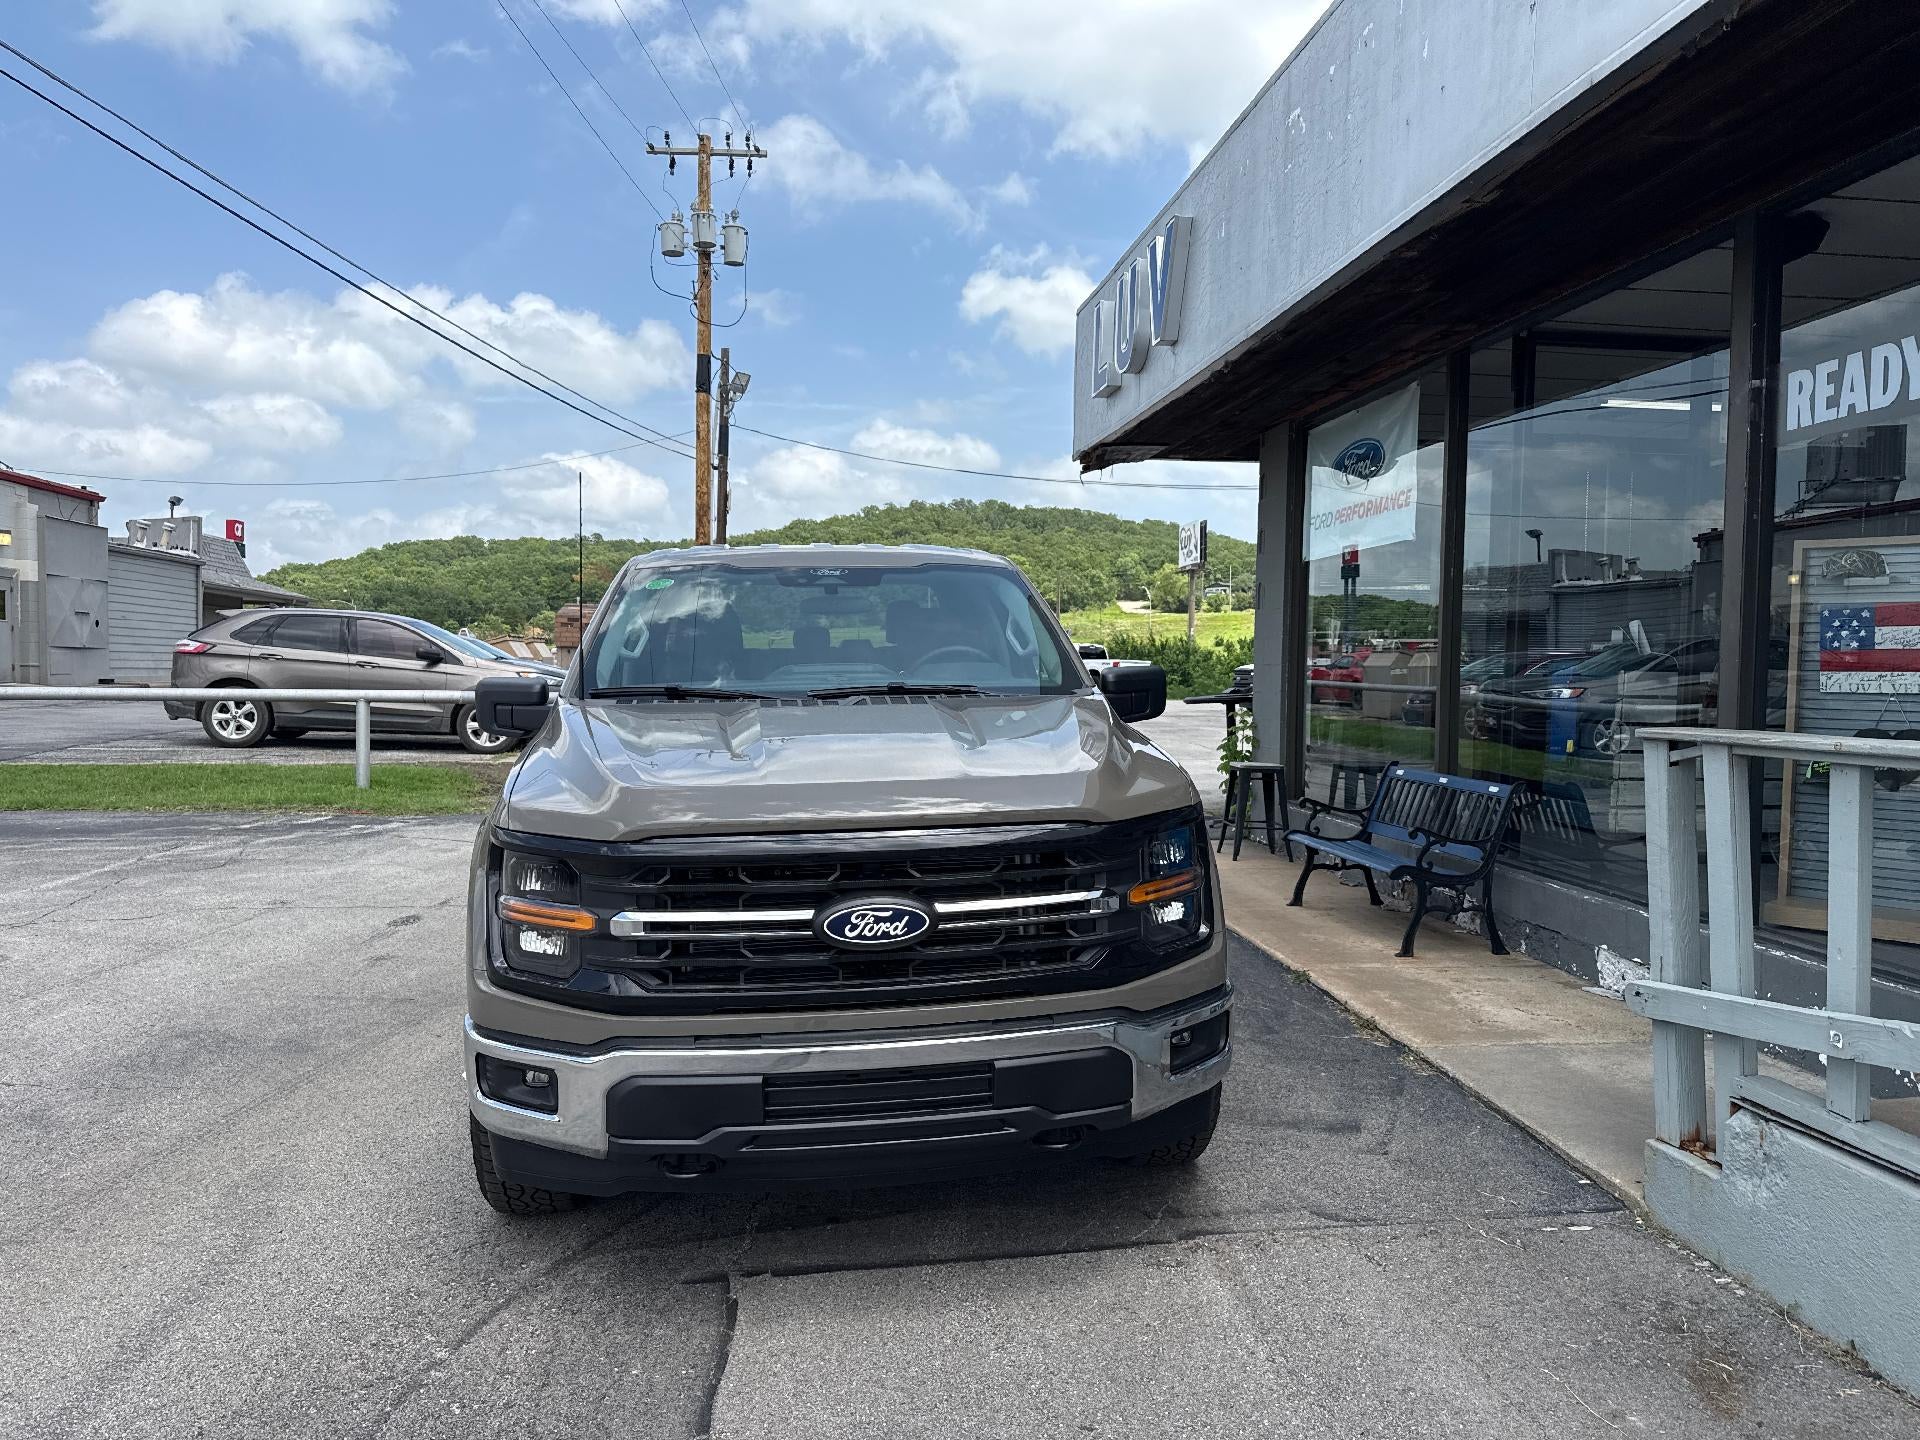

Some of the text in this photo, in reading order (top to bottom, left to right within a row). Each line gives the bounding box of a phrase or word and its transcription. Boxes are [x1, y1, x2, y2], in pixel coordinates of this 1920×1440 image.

[1092, 214, 1193, 398] LUV
[1787, 335, 1920, 431] READY
[1341, 446, 1374, 482] Ford
[1333, 488, 1413, 527] PERFORMANCE
[844, 910, 910, 938] Ford
